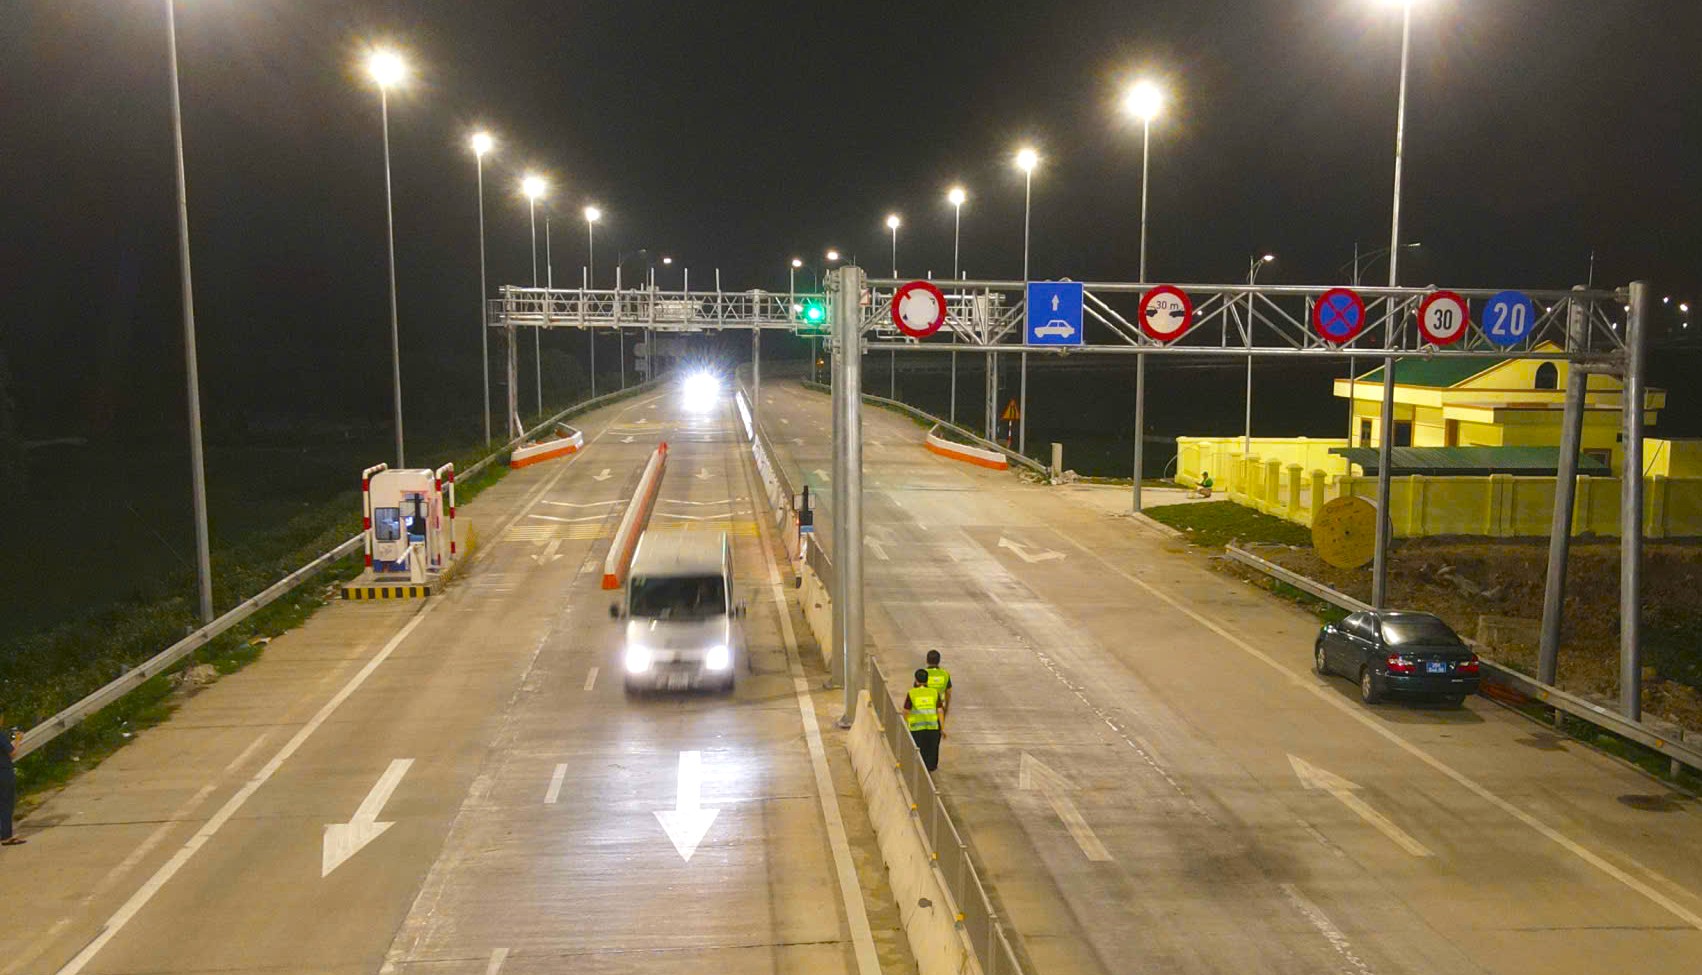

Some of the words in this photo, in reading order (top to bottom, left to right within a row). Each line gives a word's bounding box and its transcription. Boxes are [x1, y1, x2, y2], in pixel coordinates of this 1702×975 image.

[1156, 300, 1167, 310] 30
[1433, 309, 1453, 330] 30
[1492, 302, 1526, 336] 20
